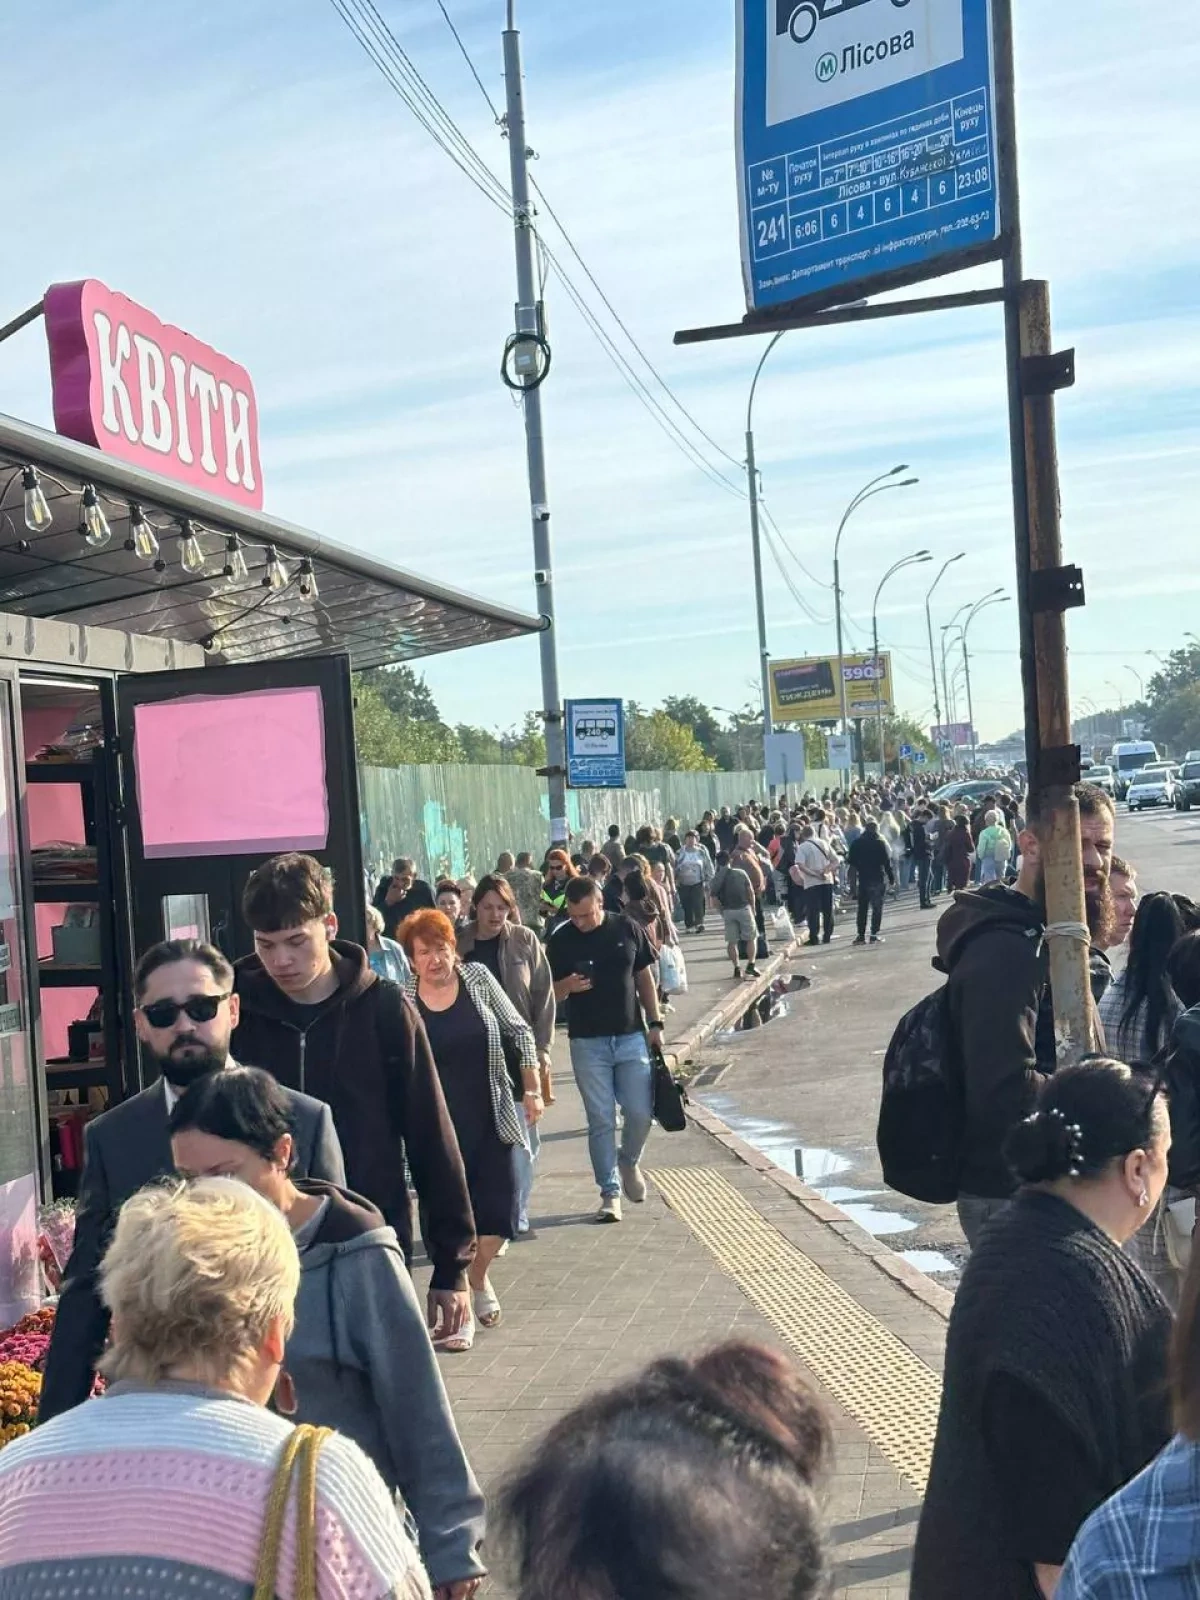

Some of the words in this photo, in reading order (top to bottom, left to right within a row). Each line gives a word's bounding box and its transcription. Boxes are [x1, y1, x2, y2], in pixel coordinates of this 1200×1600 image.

[840, 29, 915, 73] Лісова
[955, 104, 985, 119] Кінець
[960, 116, 980, 132] руху
[761, 169, 775, 182] №
[794, 171, 813, 187] руху
[958, 166, 988, 190] 23:08
[757, 182, 780, 197] м-ту
[838, 180, 871, 200] Лісова
[939, 180, 947, 196] 6
[884, 197, 892, 212] 6
[911, 189, 920, 204] 4
[857, 205, 866, 220] 4
[831, 213, 839, 229] 6
[757, 214, 786, 248] 241
[795, 220, 818, 240] 6:06
[93, 311, 256, 491] КВІТИ
